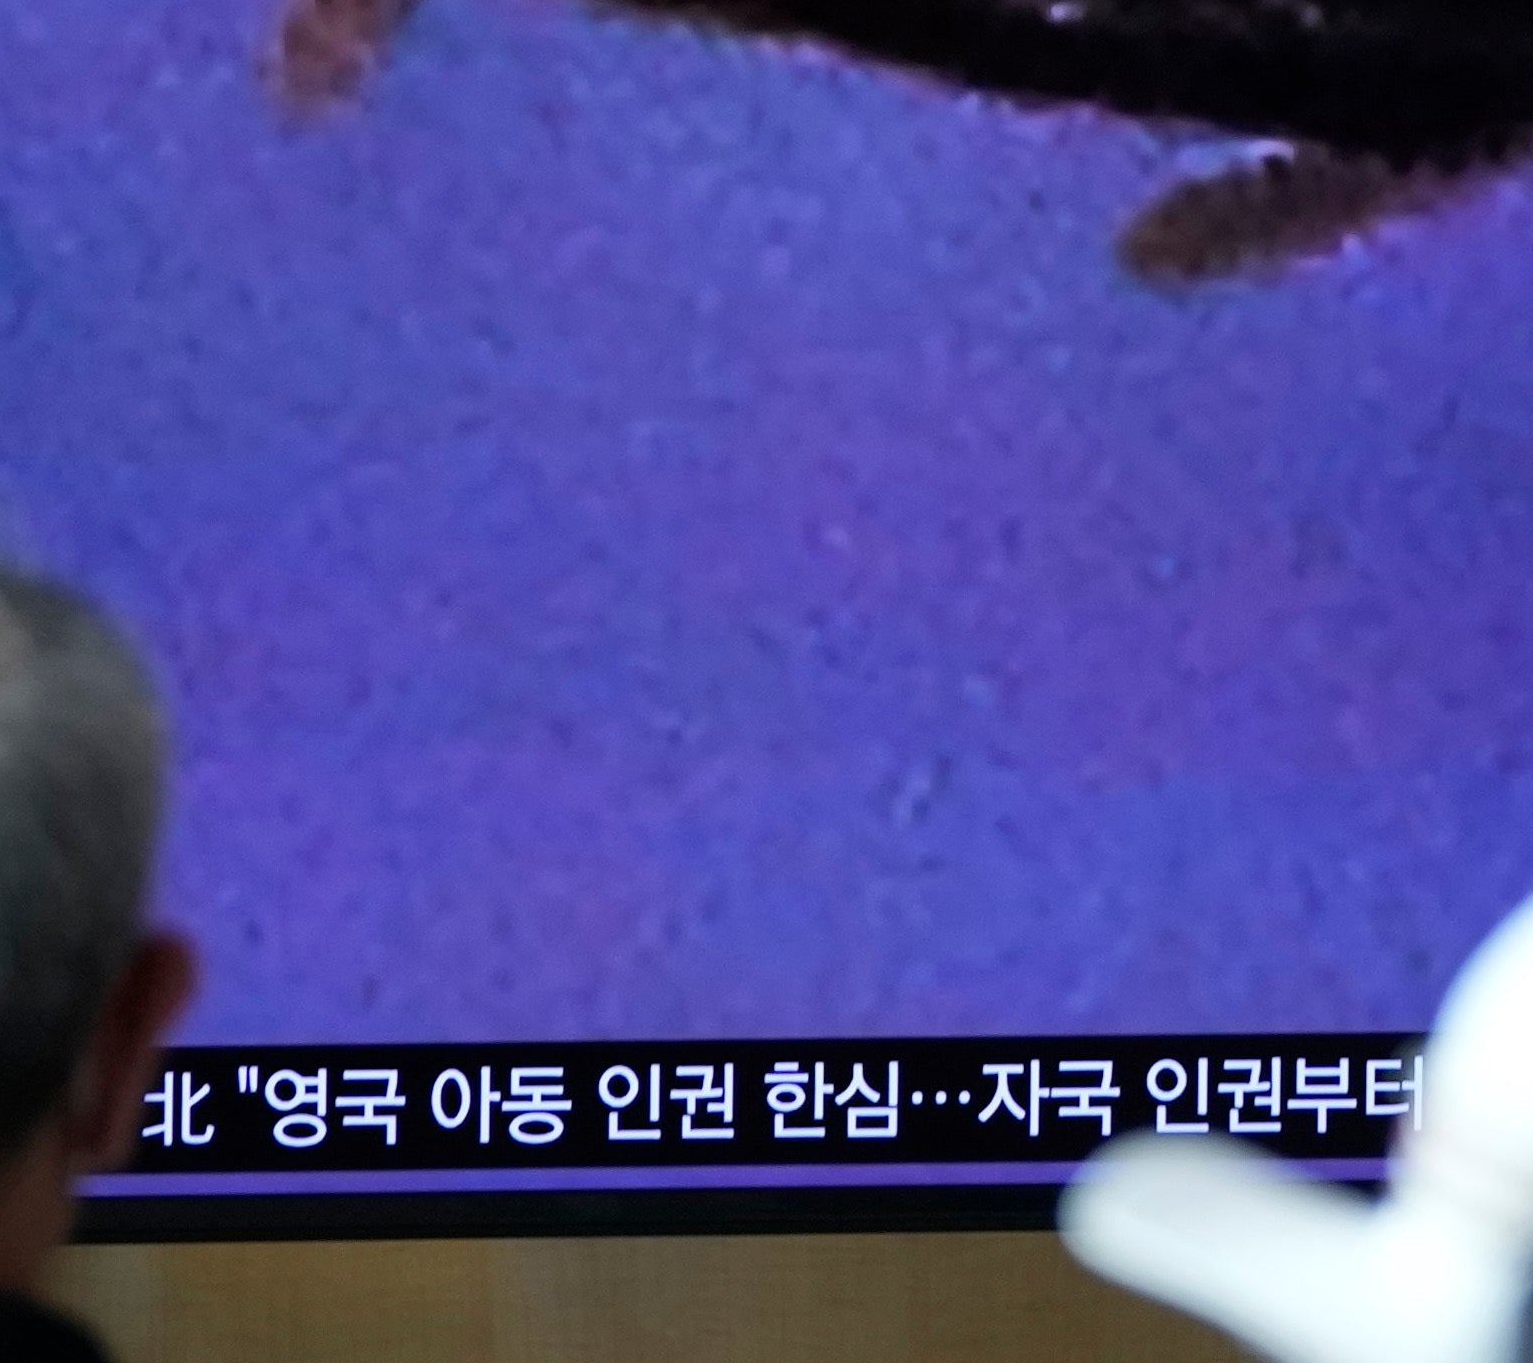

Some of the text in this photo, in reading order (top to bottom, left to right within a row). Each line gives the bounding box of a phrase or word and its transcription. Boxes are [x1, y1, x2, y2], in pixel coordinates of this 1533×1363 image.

[142, 1071, 215, 1147] 北
[238, 1065, 406, 1148] "영국
[431, 1065, 573, 1145] 아동
[598, 1062, 736, 1140] 인권
[1146, 1055, 1424, 1133] 인권부터
